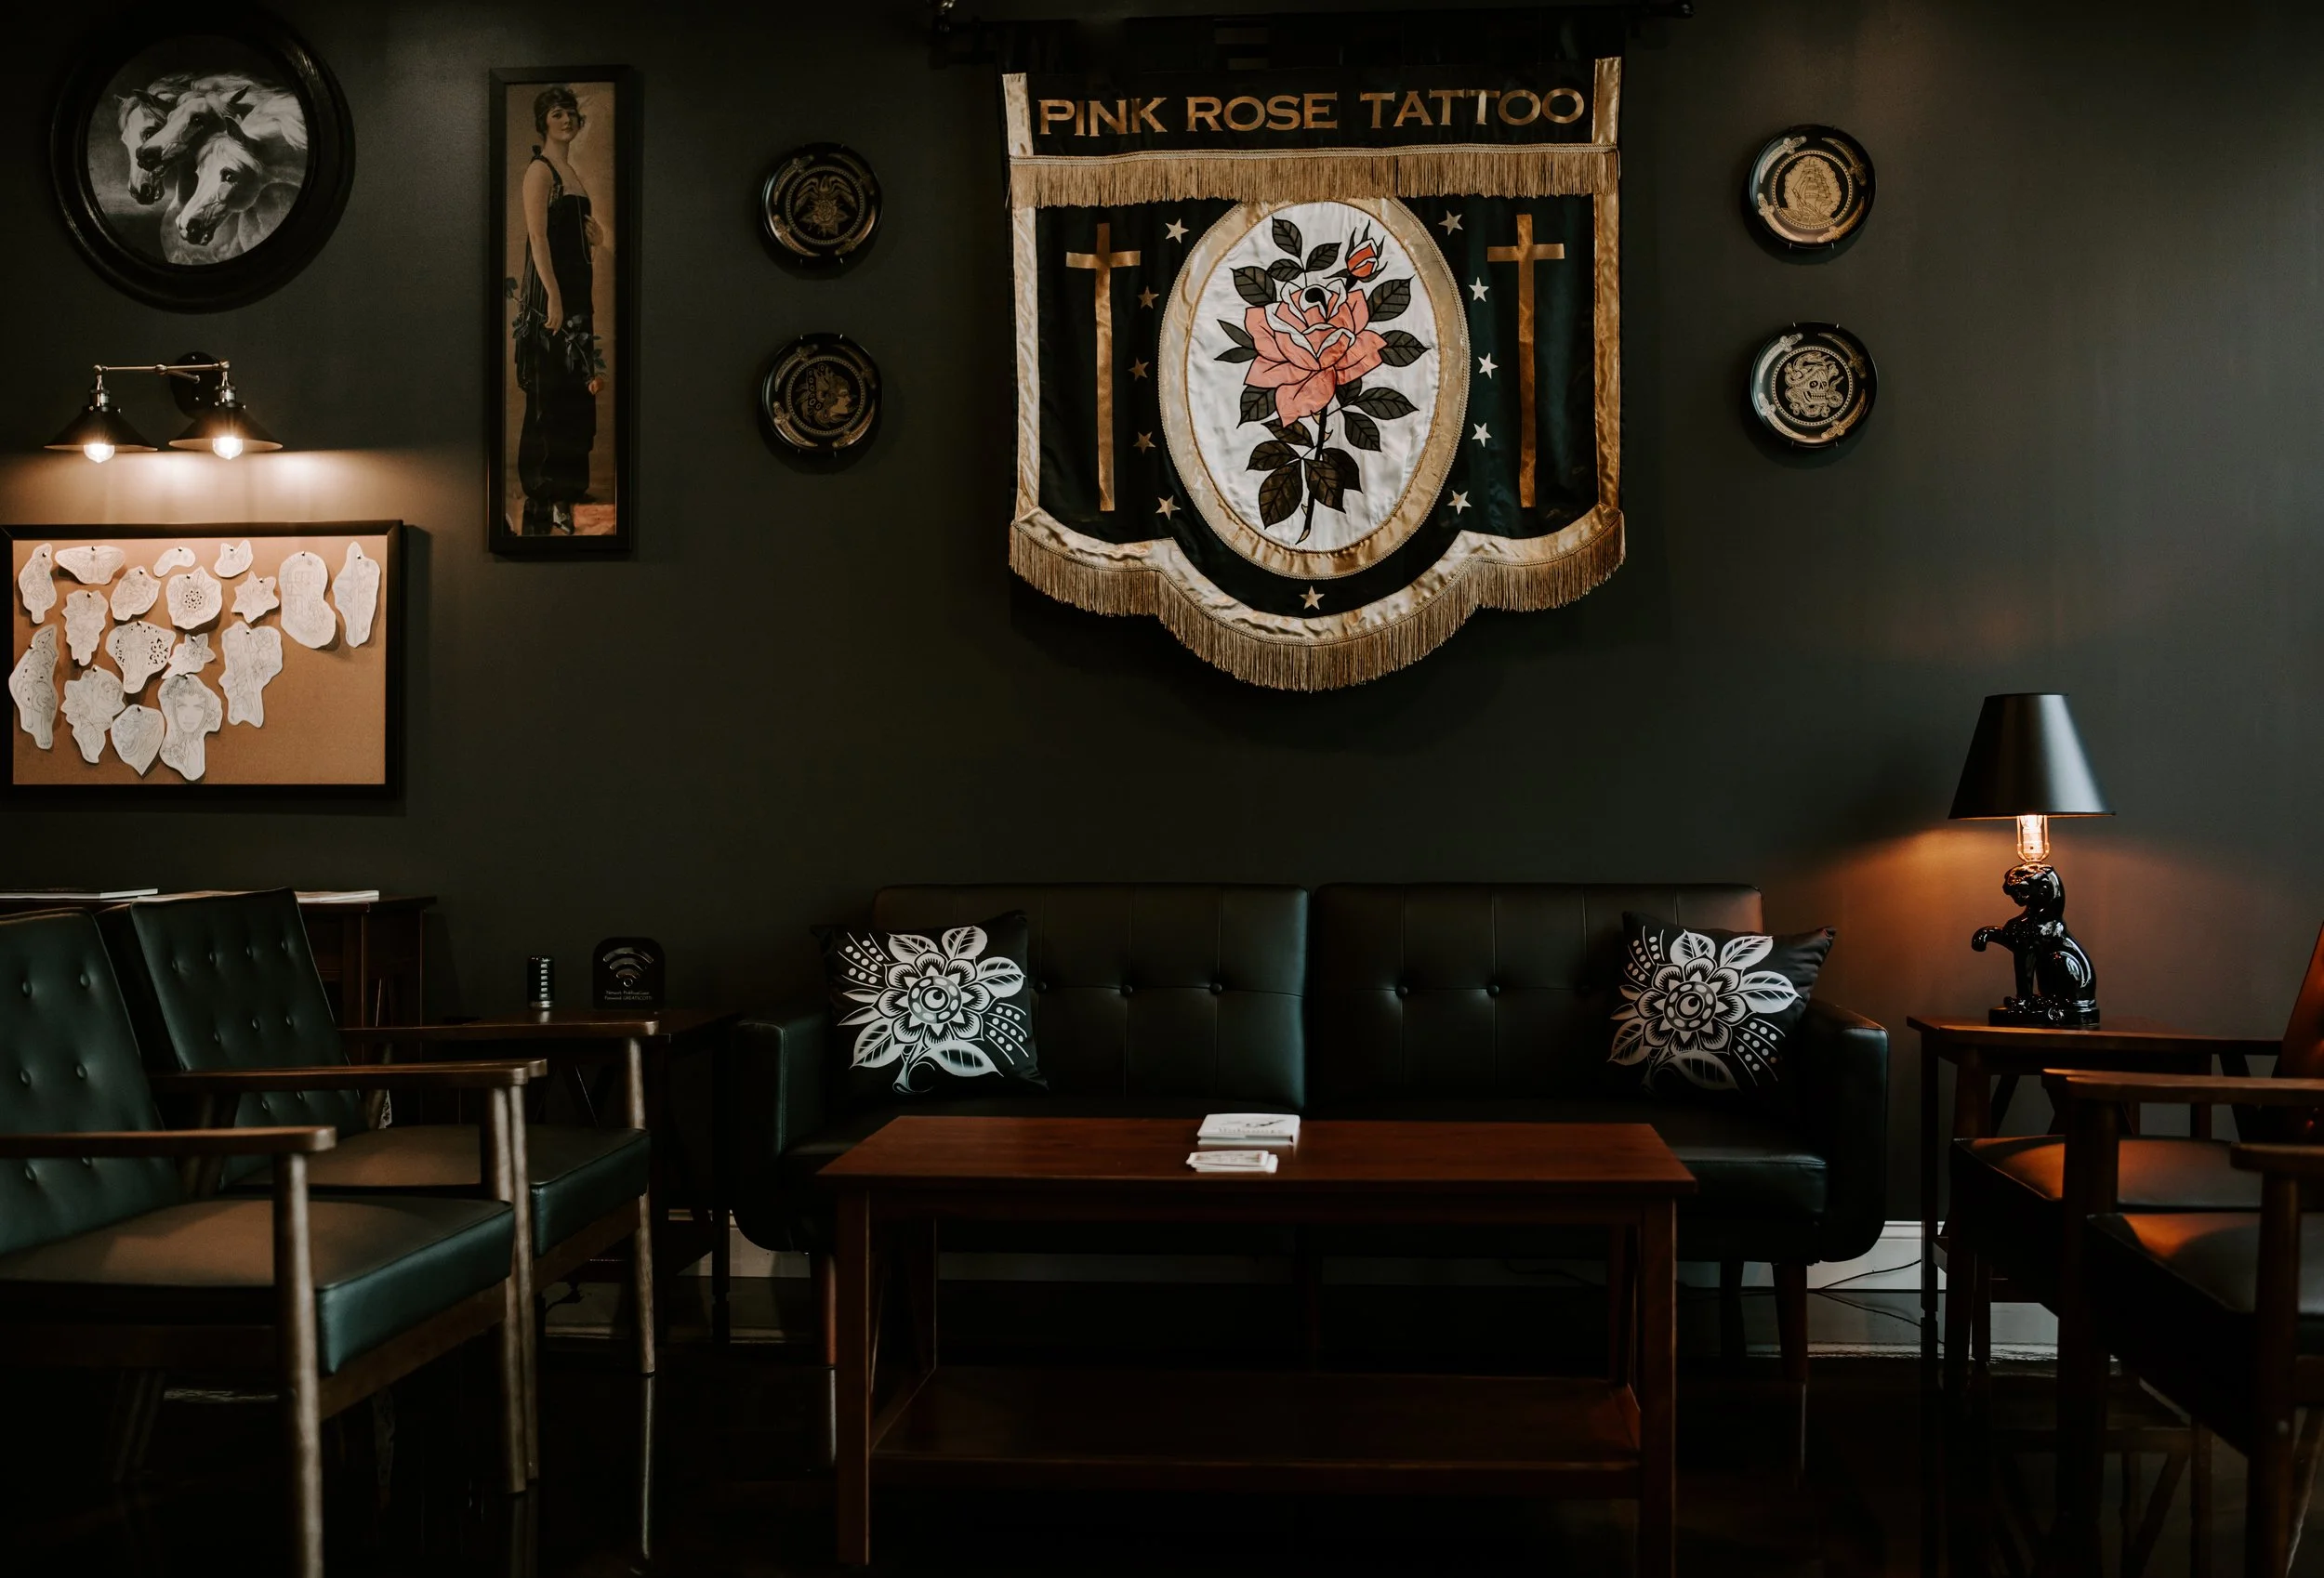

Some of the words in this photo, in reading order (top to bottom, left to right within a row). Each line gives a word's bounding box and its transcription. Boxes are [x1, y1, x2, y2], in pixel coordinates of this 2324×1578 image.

[1037, 97, 1168, 137] PINK
[1185, 92, 1337, 131] ROSE
[1360, 87, 1585, 129] TATTOO
